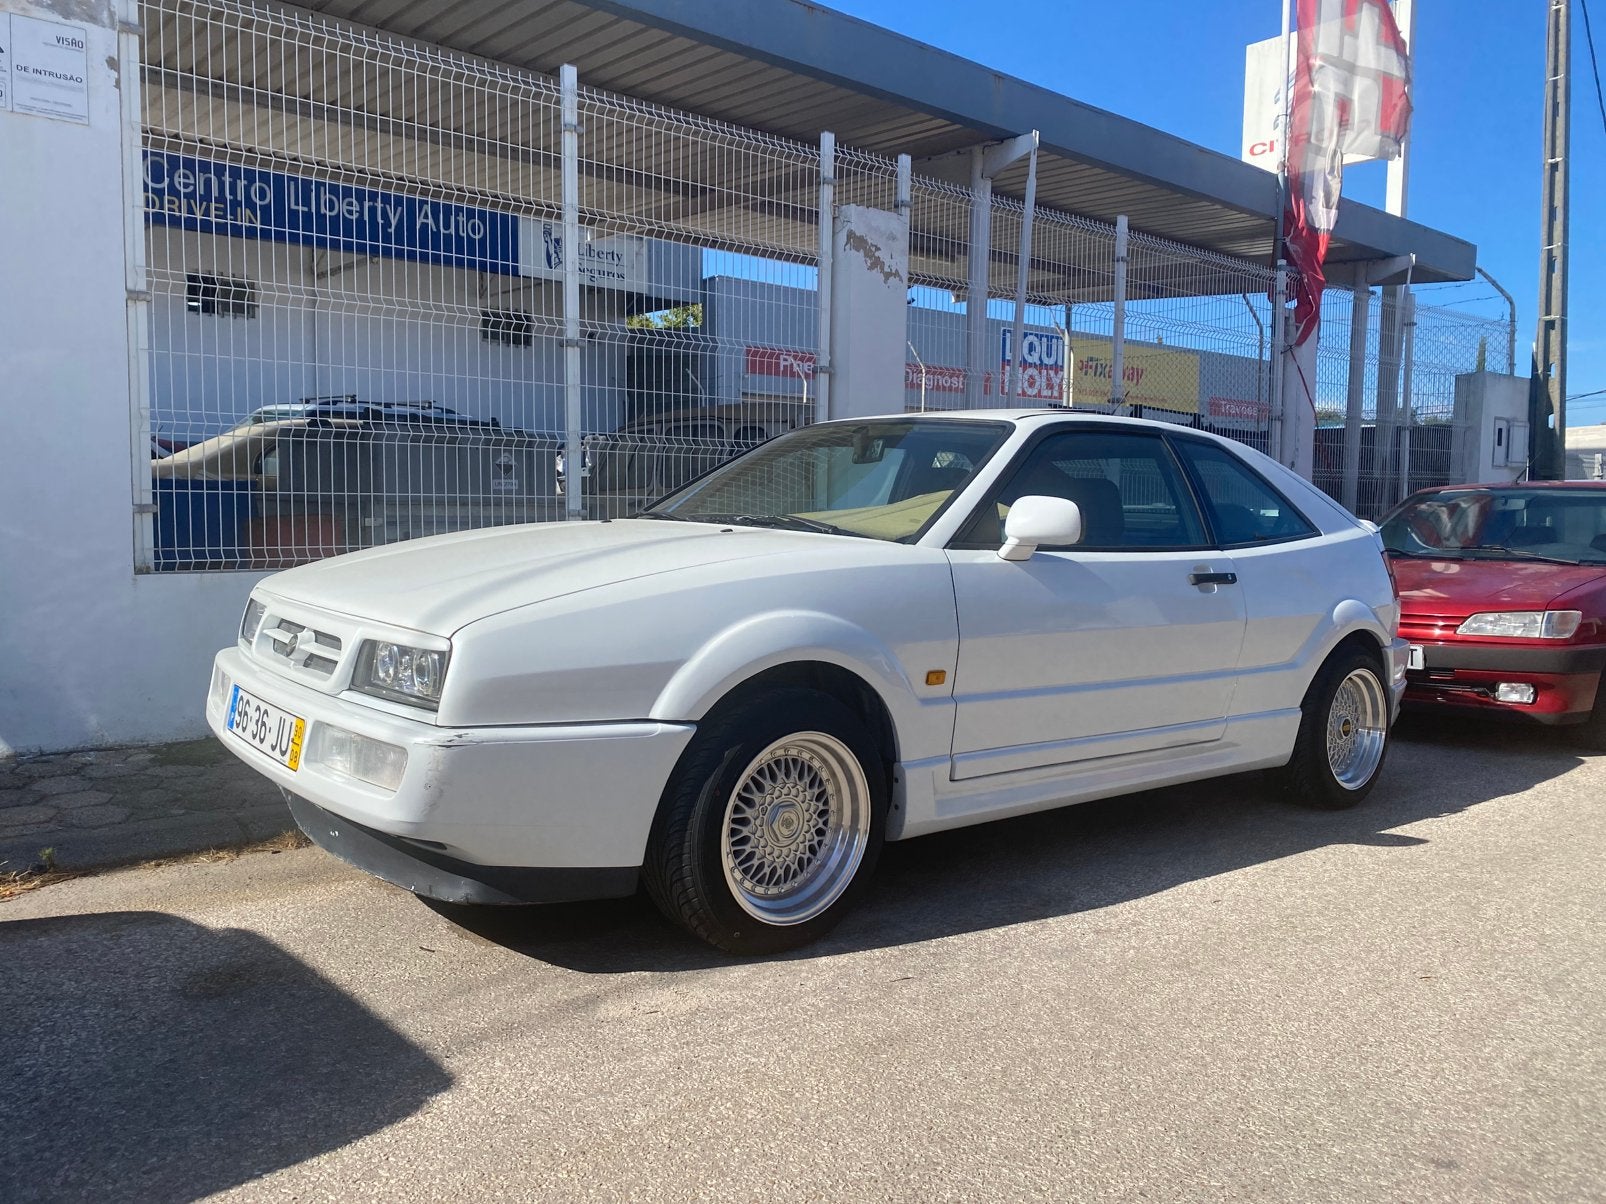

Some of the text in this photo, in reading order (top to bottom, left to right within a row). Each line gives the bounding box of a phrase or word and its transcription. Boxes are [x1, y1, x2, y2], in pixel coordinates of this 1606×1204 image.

[16, 64, 30, 73] DE
[142, 156, 484, 239] Centro Liberty Auto
[578, 242, 623, 267] Liberty
[1004, 332, 1064, 366] LQUI
[780, 354, 815, 374] Pne
